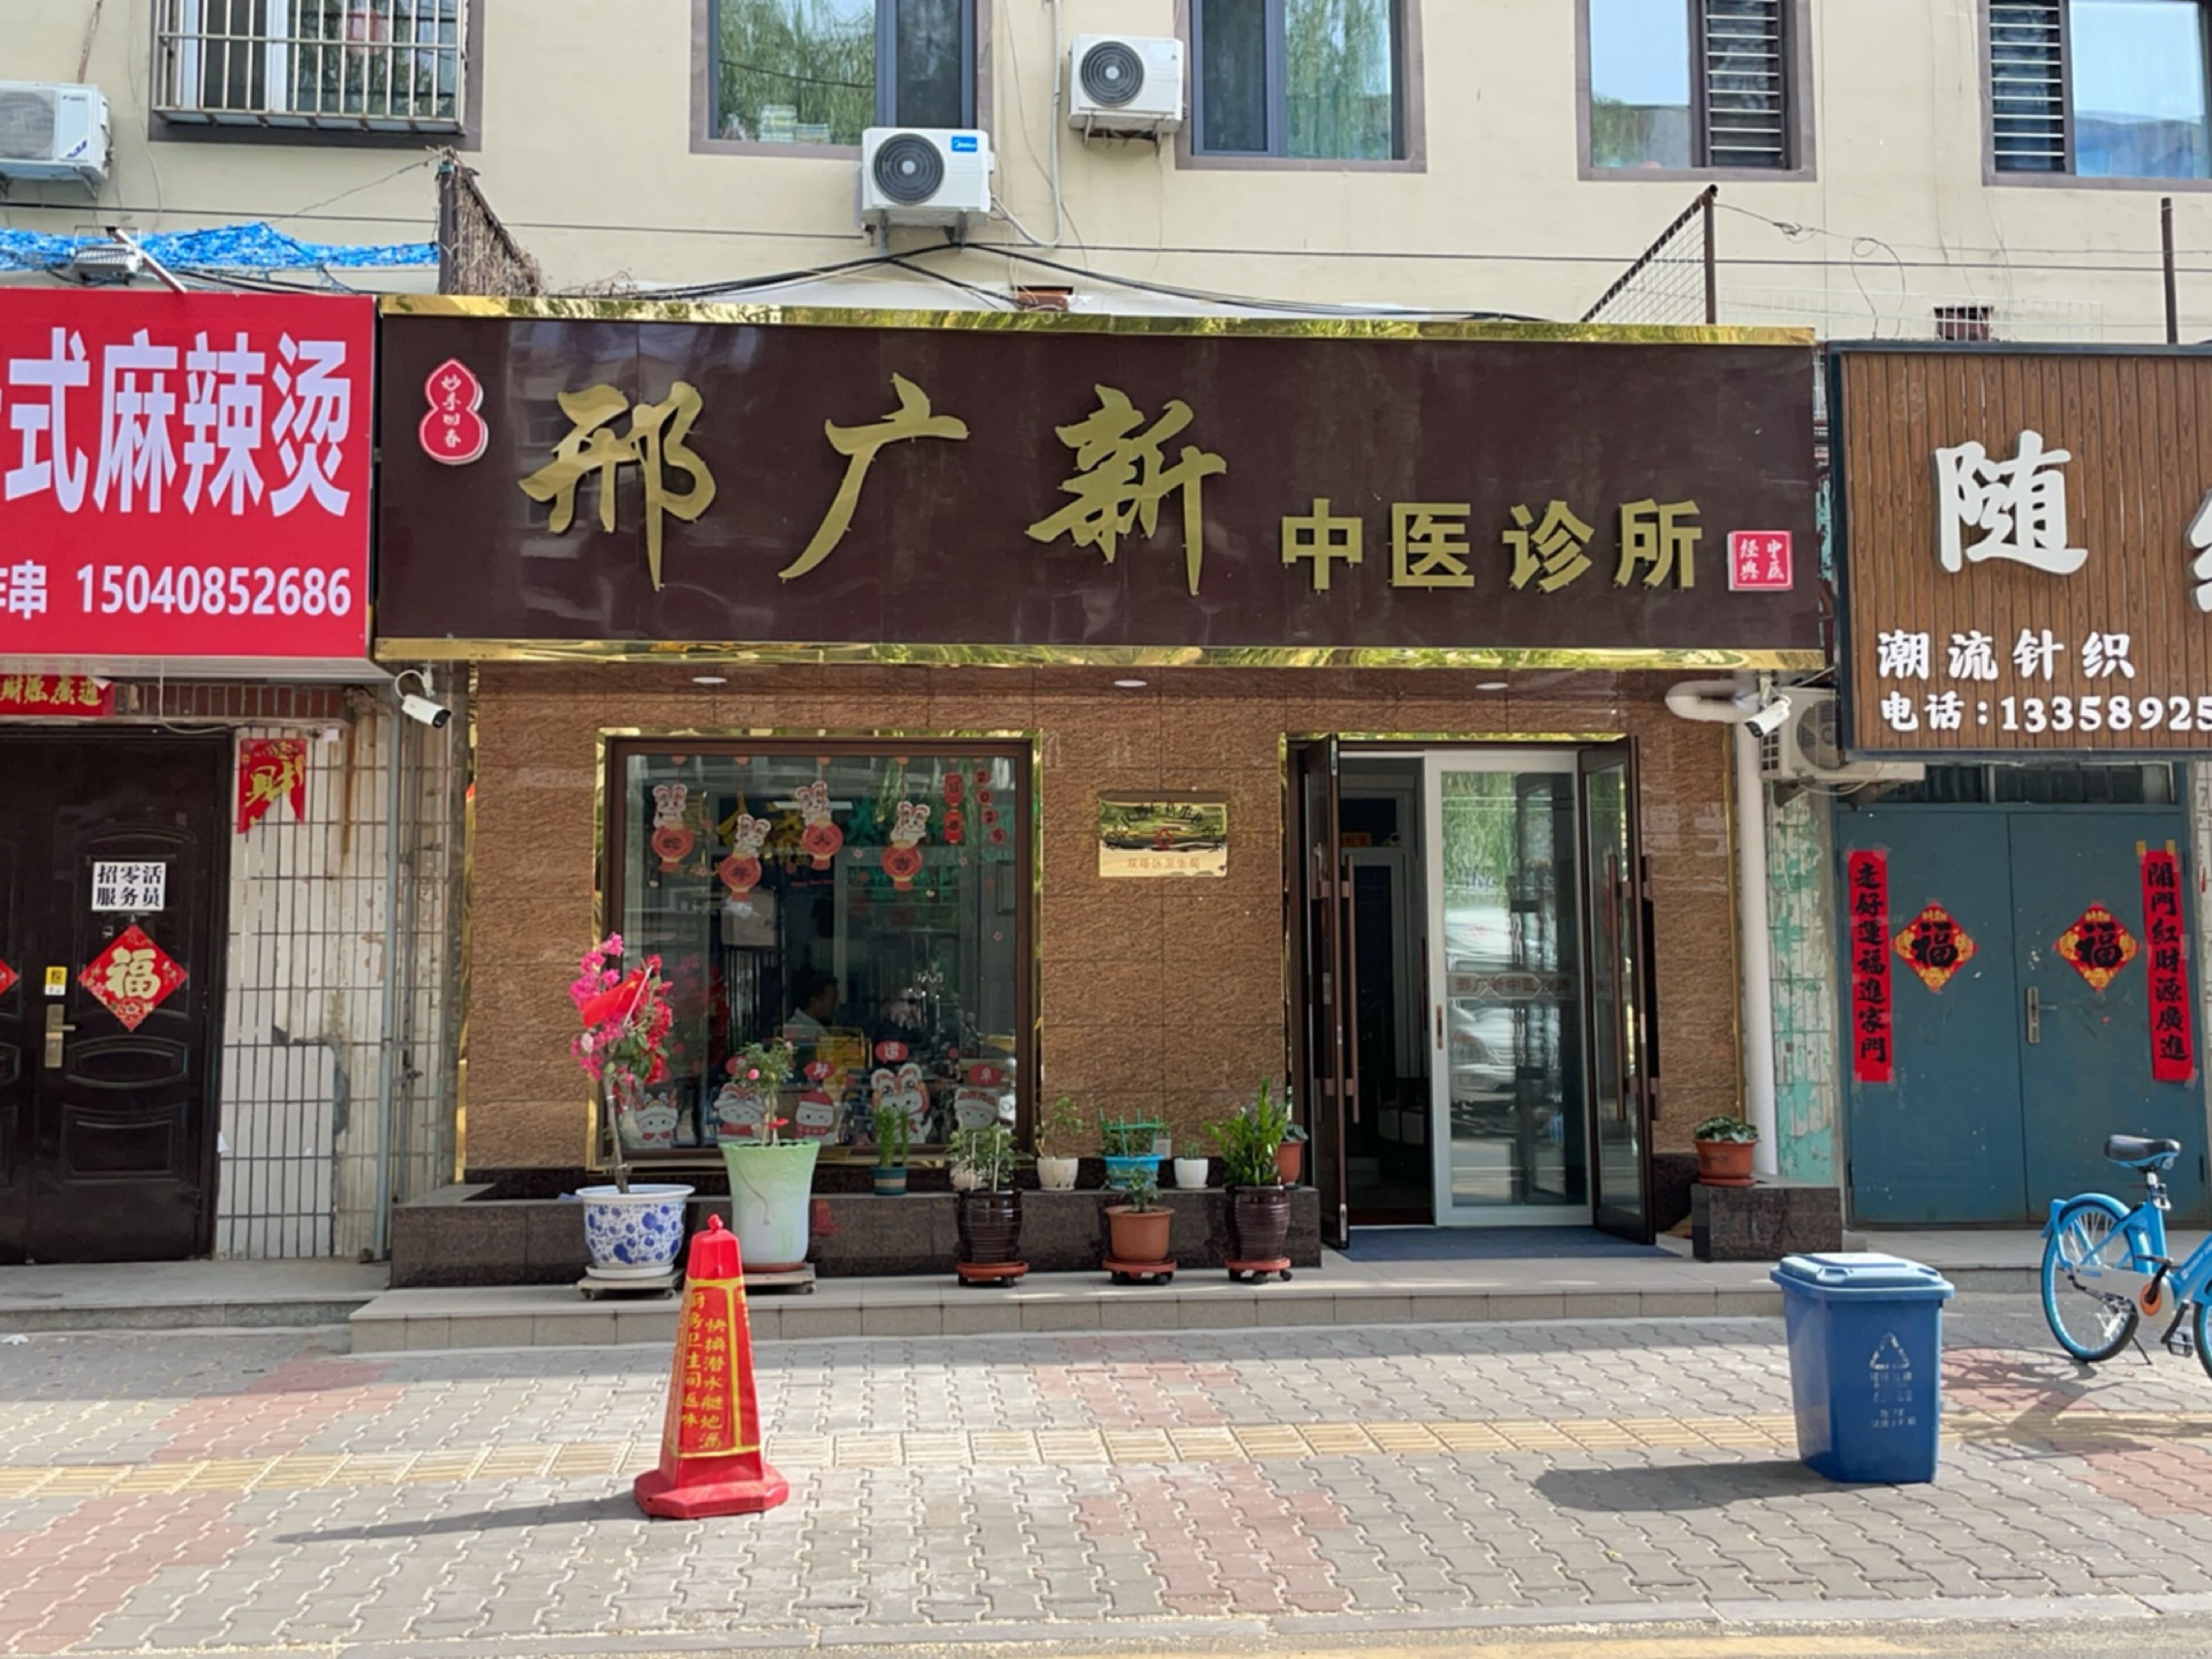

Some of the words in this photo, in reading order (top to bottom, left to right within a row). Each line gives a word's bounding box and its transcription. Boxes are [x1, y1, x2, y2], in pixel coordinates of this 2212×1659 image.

[5, 327, 351, 517] 式麻辣烫
[517, 372, 1228, 597] 邢广新
[1281, 497, 1703, 593] 中医诊所
[0, 559, 47, 620] 串
[76, 563, 351, 616] 15040852686
[1877, 629, 2135, 681] 潮流针织
[96, 886, 161, 907] 服务员
[97, 865, 163, 885] 招零活
[1910, 922, 1959, 968] 福
[2074, 922, 2124, 968] 福
[105, 945, 161, 1000] 福
